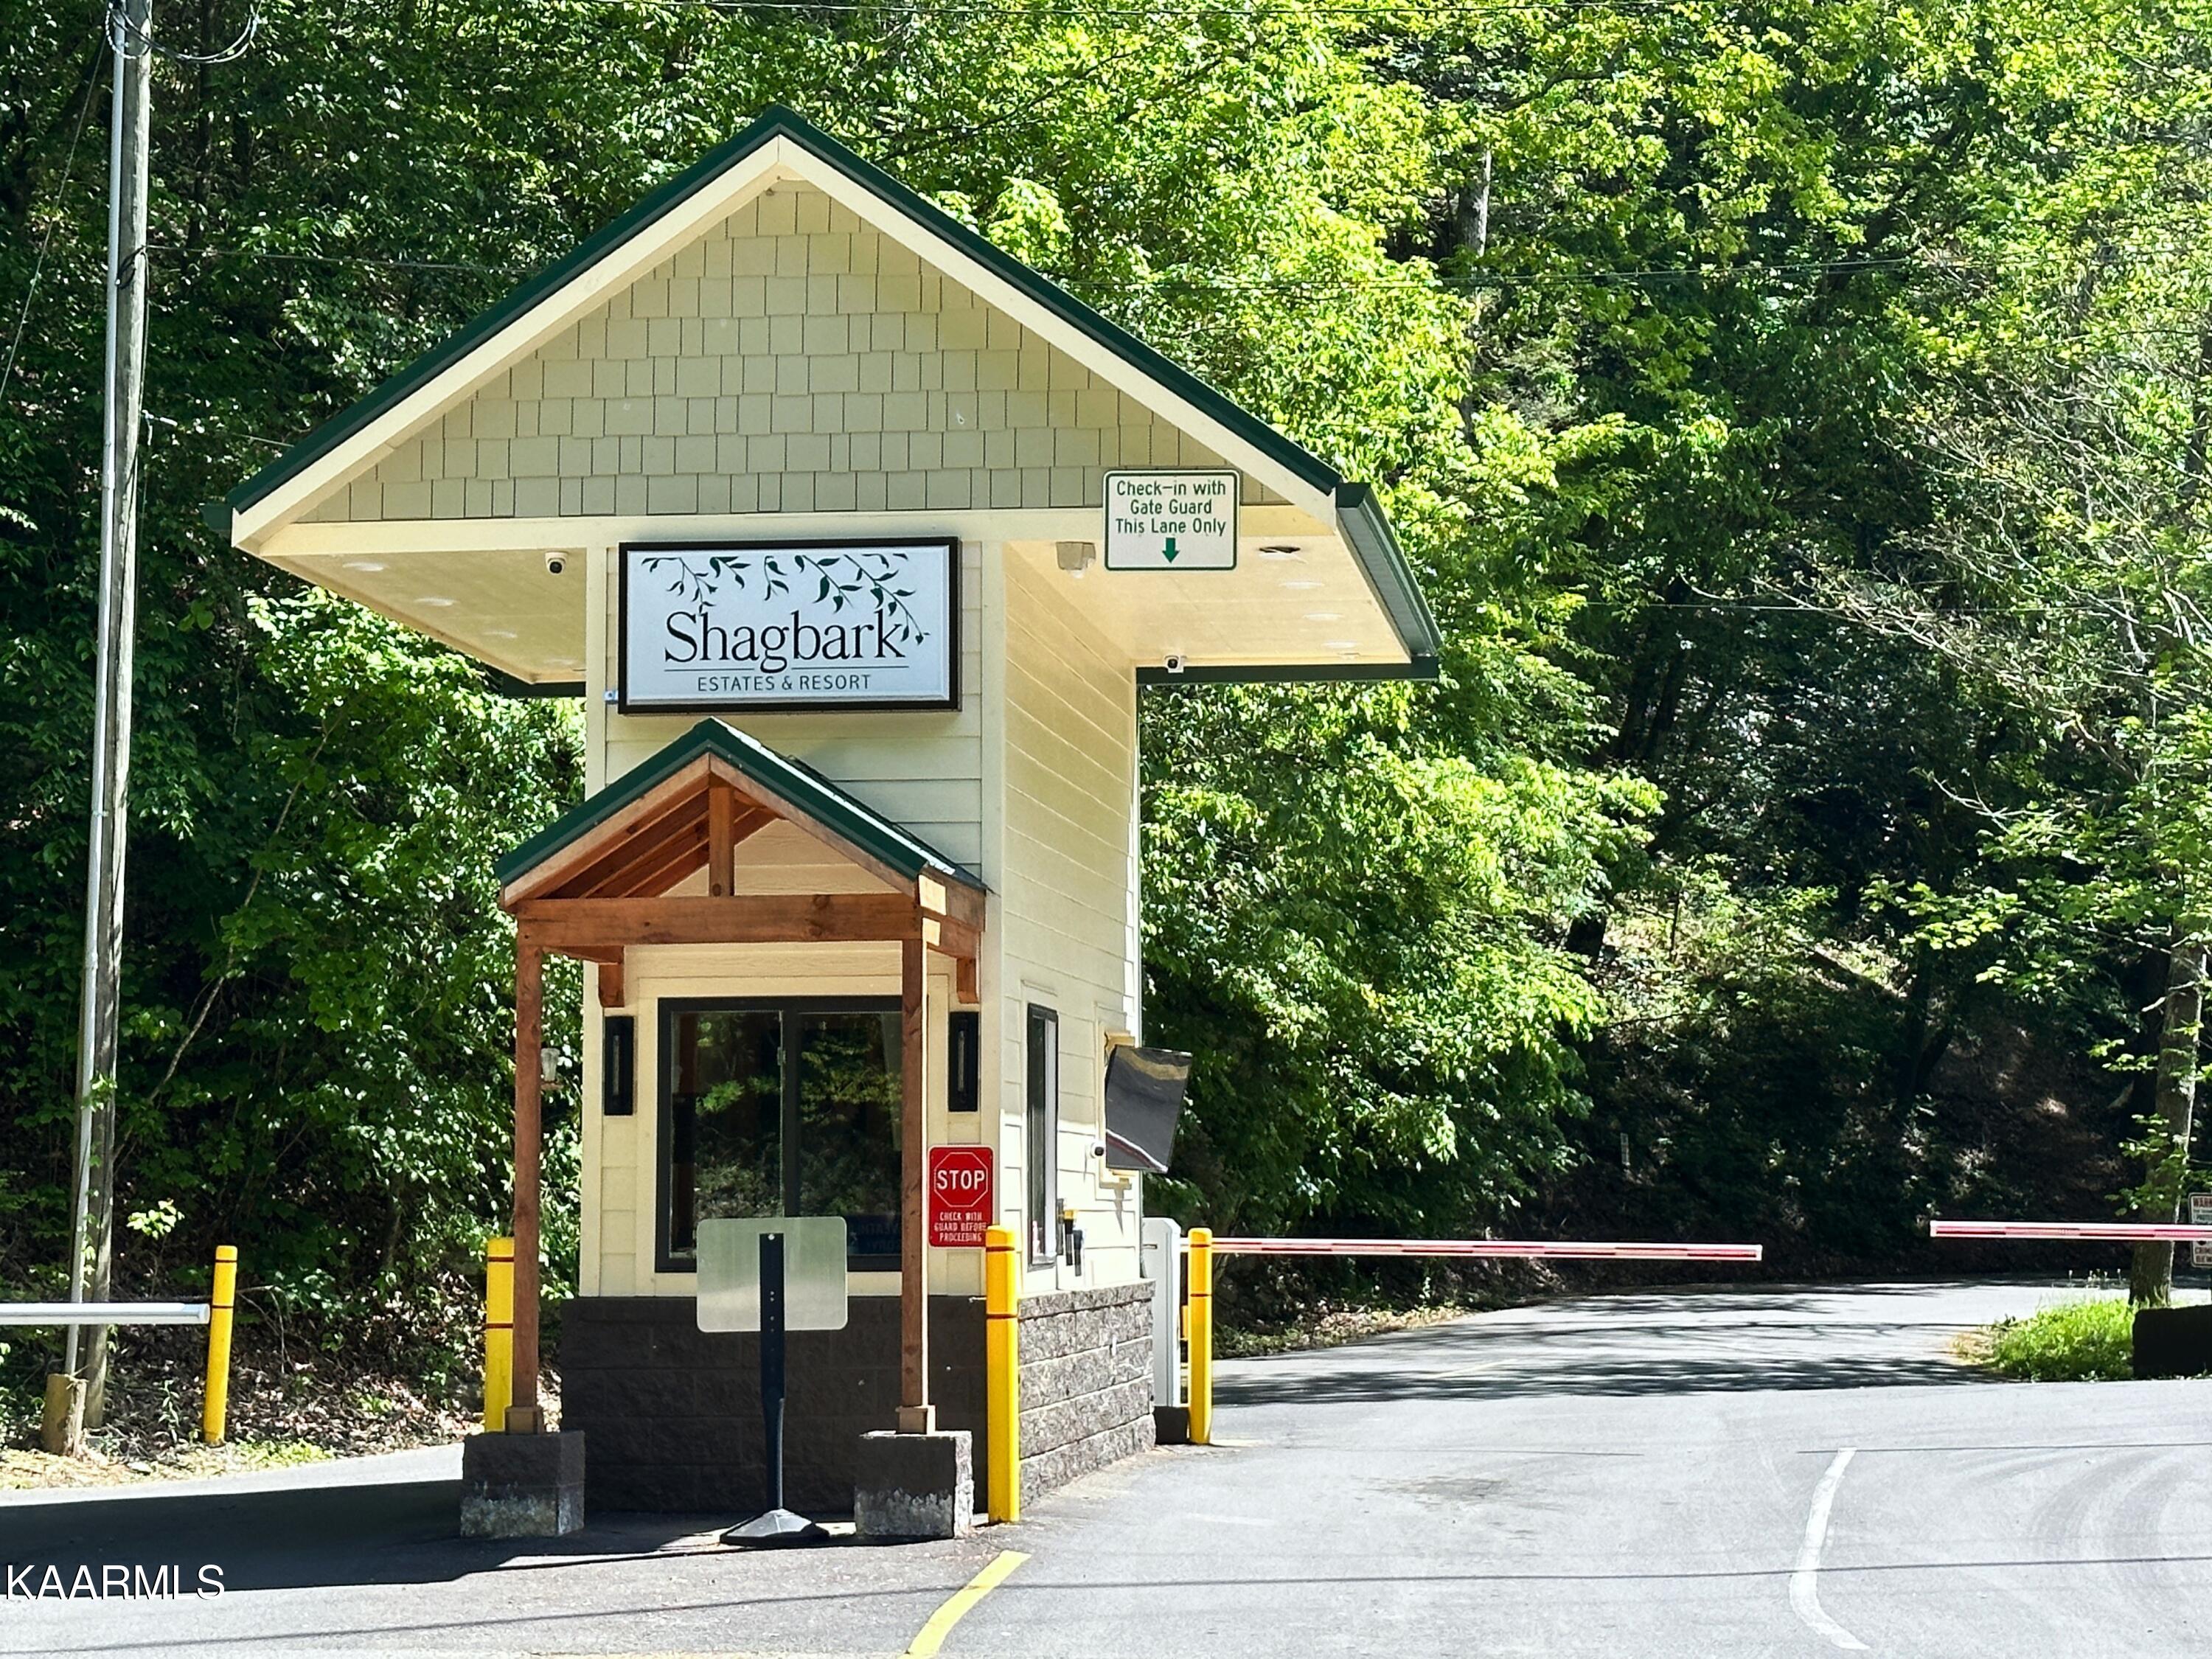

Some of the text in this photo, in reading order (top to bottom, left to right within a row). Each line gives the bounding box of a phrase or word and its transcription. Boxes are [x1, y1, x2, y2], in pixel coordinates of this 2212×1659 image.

[1116, 480, 1225, 495] Check-in with
[1130, 499, 1212, 514] Gate Guard
[1116, 518, 1226, 537] This Lane Only
[664, 608, 905, 674] Shagbark
[698, 674, 872, 692] ESTATES & RESORT
[936, 1169, 985, 1190] STOP
[939, 1211, 982, 1221] CHECK WITH
[933, 1222, 987, 1231] GUARD BEFORE
[939, 1232, 982, 1242] PROCEEDING
